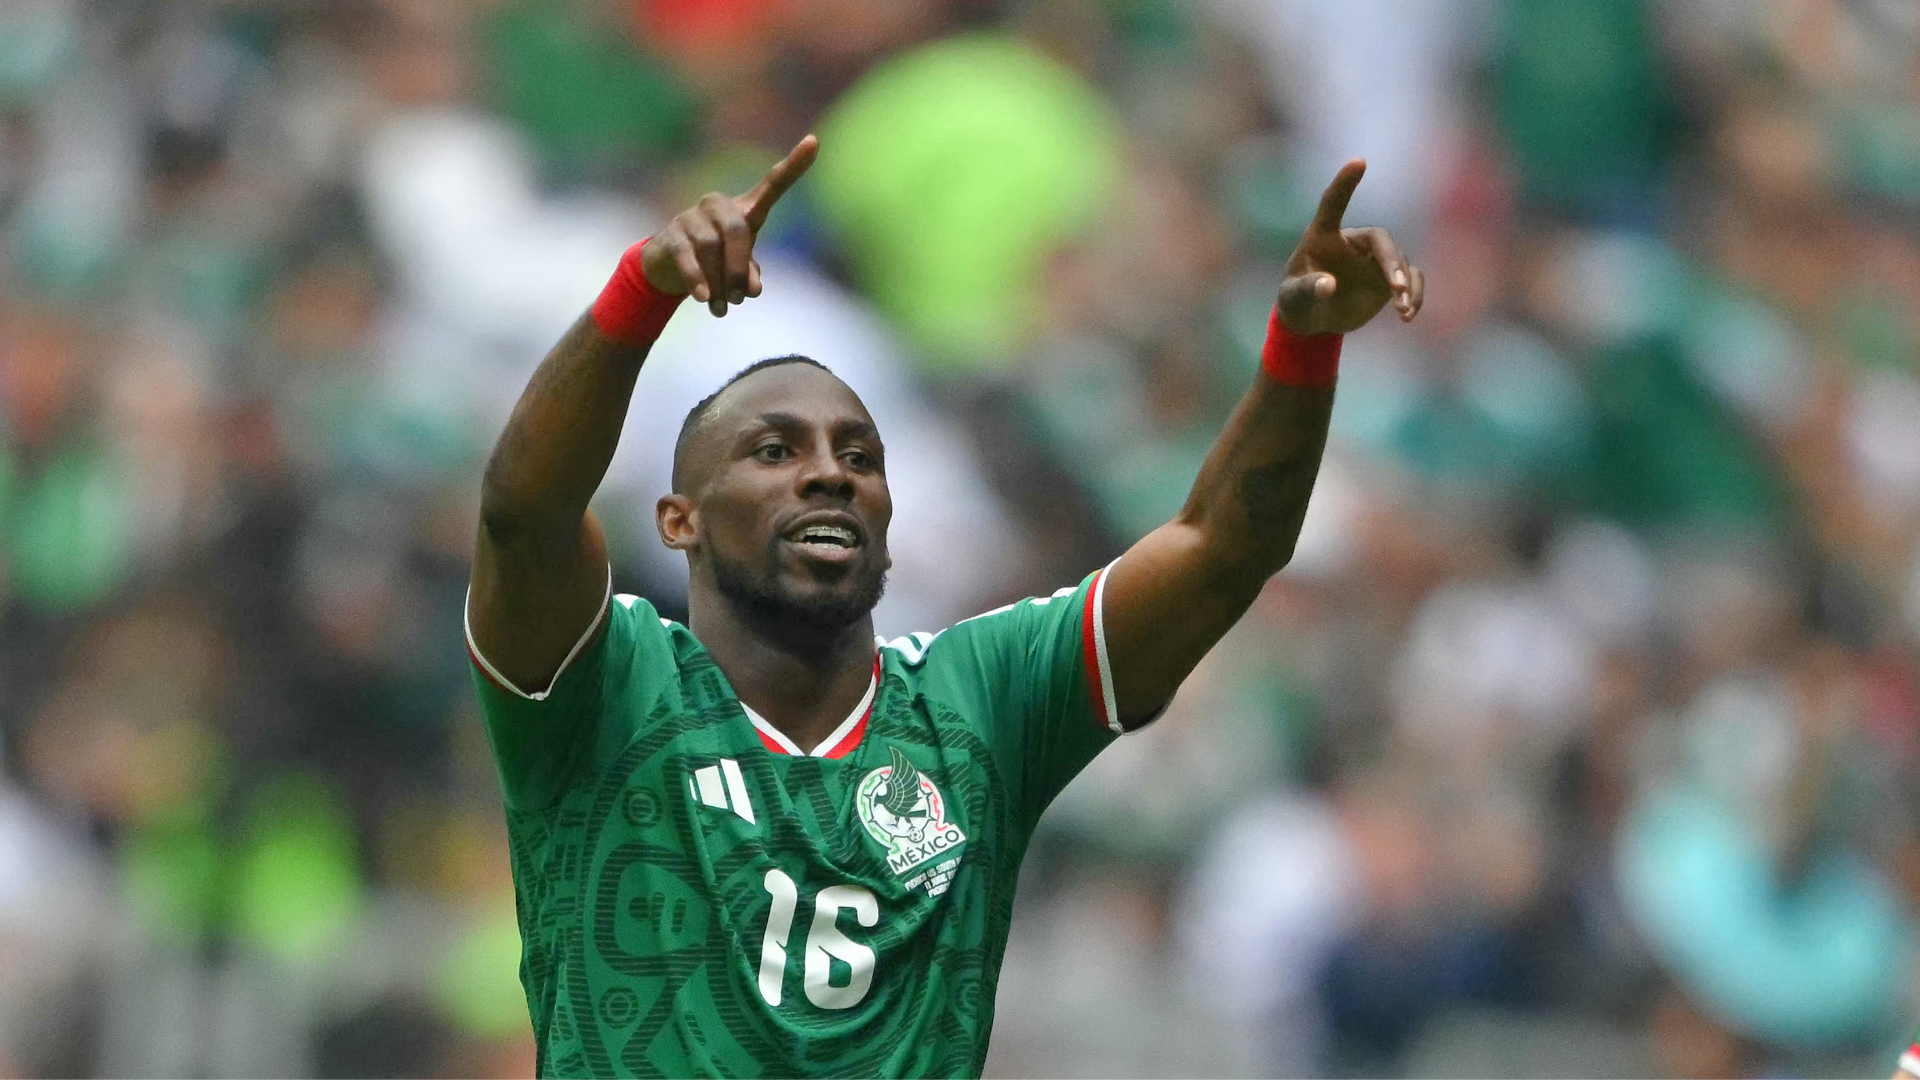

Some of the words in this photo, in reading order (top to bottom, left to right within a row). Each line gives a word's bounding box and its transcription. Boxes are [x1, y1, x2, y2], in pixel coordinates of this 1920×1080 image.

[889, 829, 960, 872] MÉXICO
[935, 859, 957, 873] SOUTH
[758, 869, 879, 1010] 16
